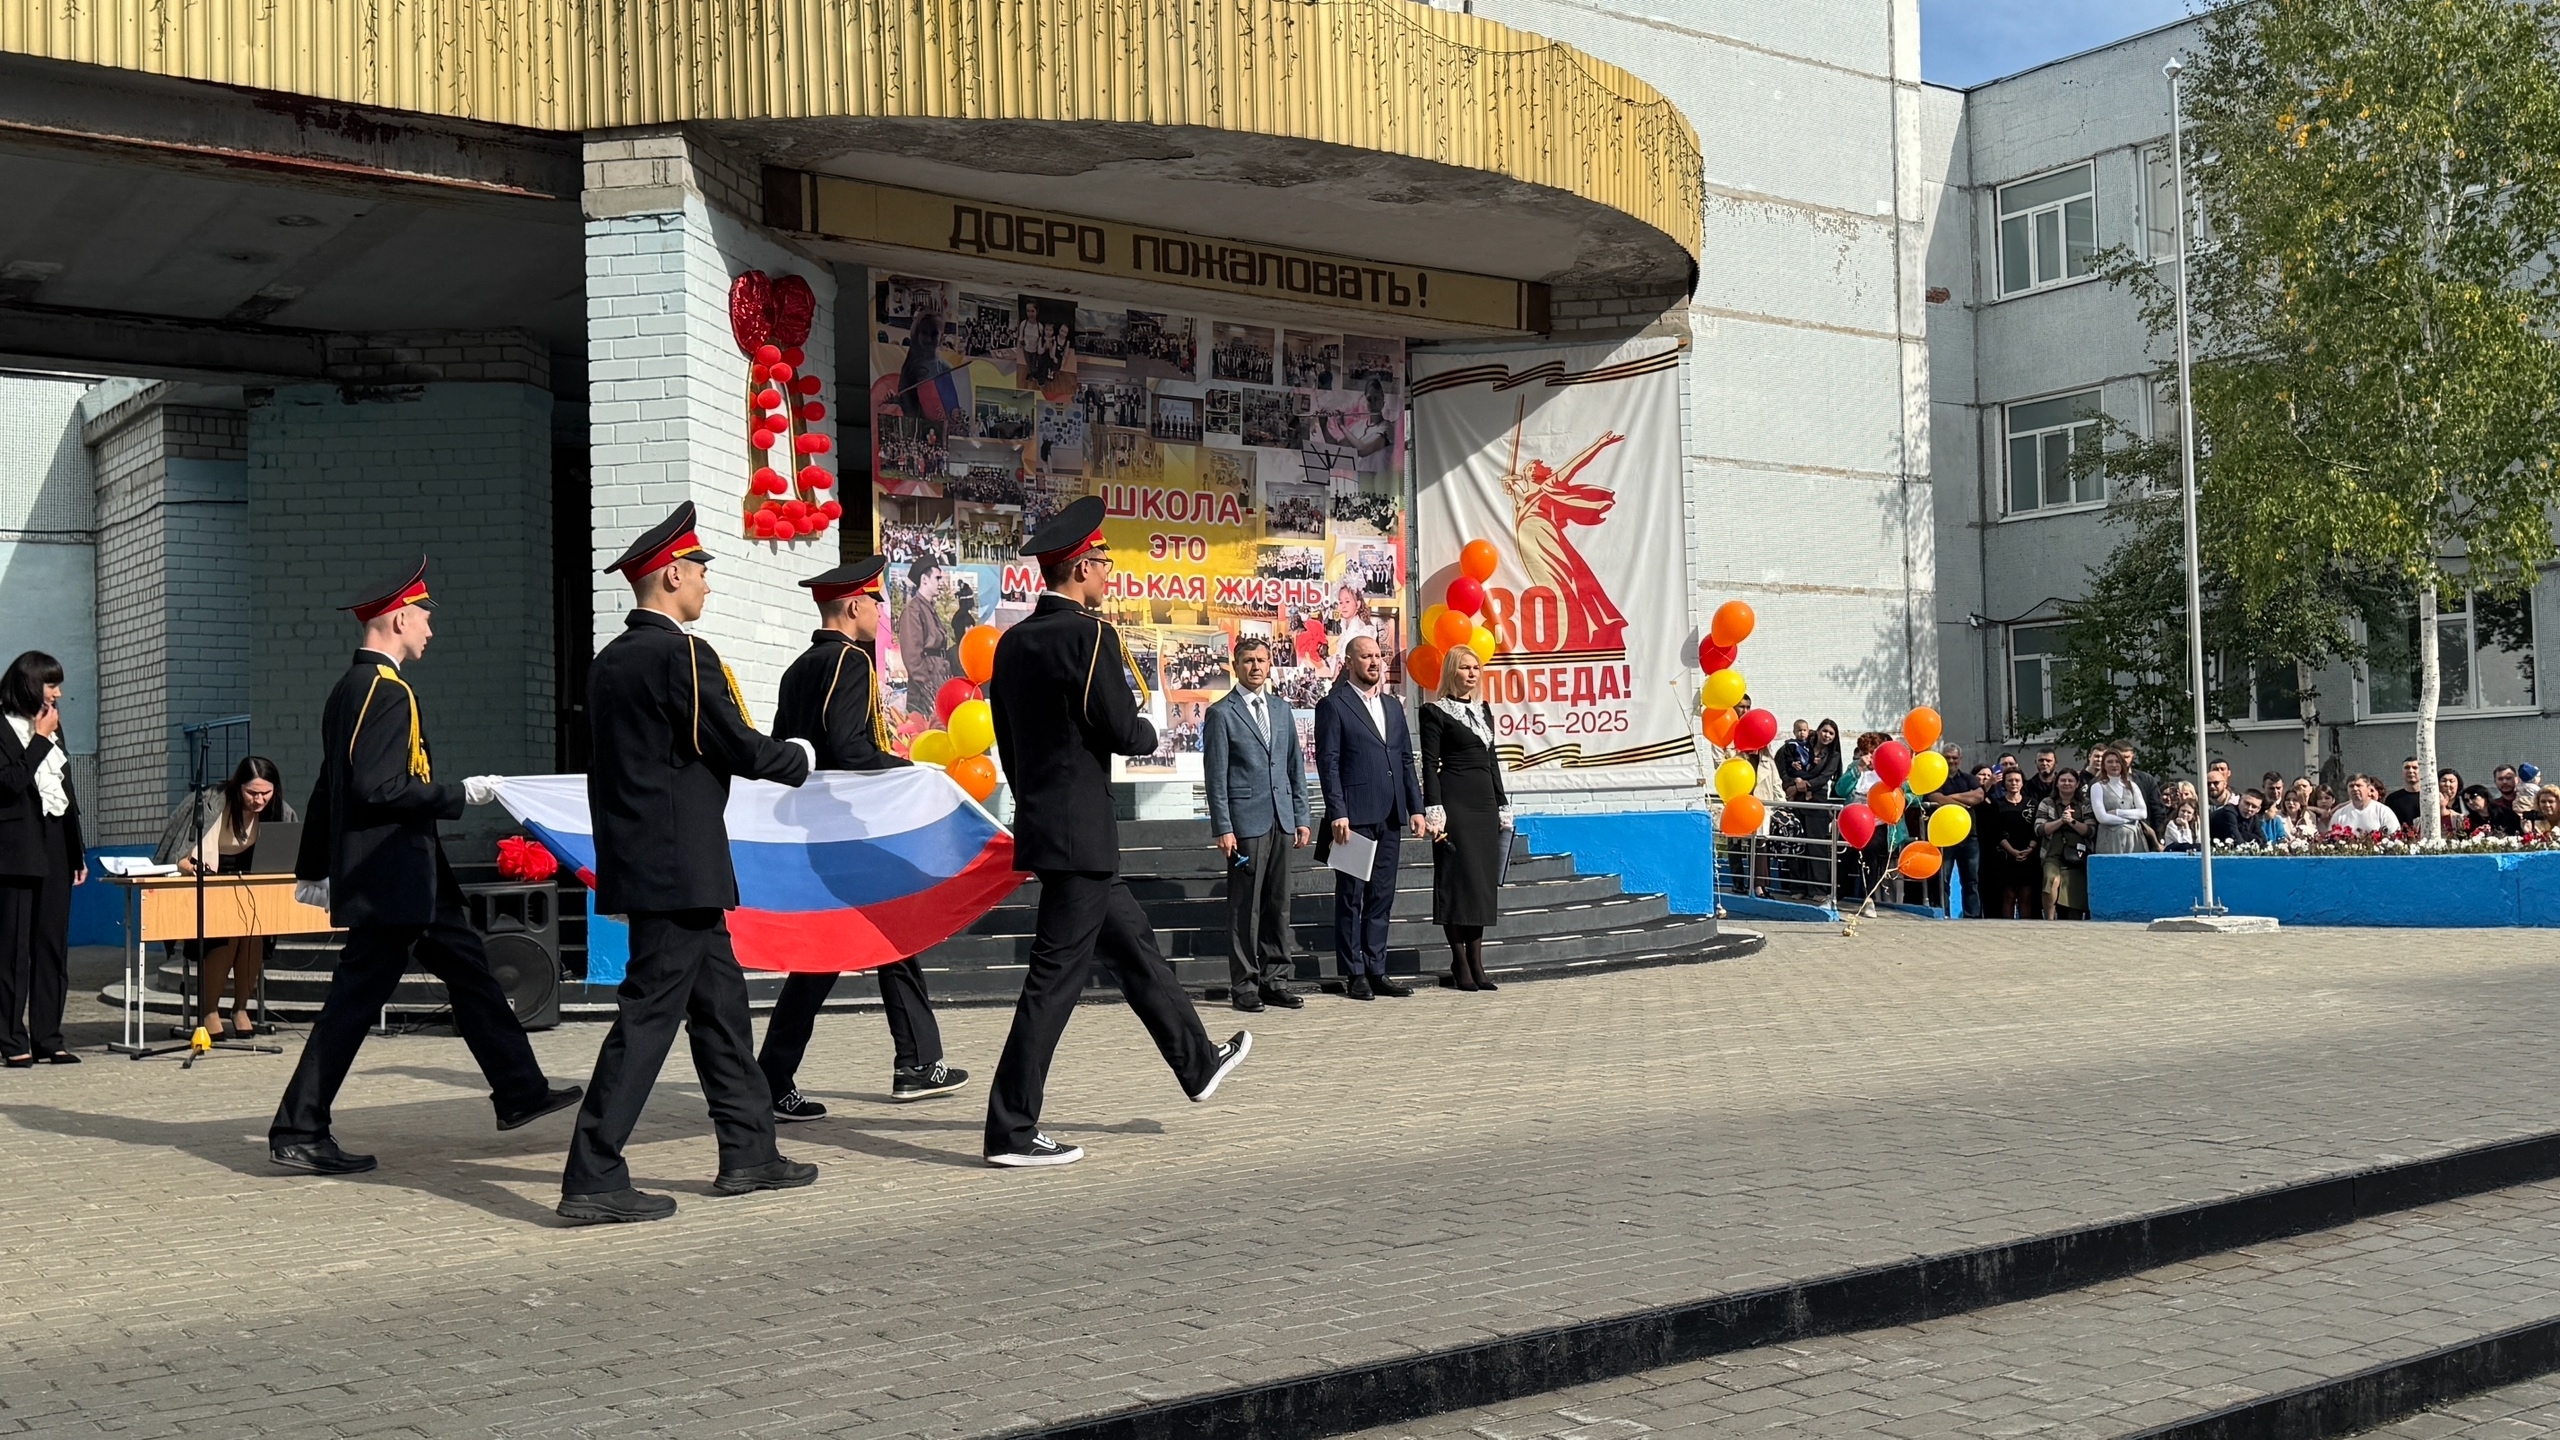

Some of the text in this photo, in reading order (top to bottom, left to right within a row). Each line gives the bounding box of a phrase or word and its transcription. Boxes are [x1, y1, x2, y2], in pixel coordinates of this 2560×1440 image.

[950, 204, 1105, 264] ДОБРО
[1149, 534, 1207, 562] ЭТО
[1003, 566, 1331, 606] МНЬКАЯ ЖИЗНЬ!
[1481, 586, 1558, 653] 80
[1483, 664, 1631, 707] ПОБЕДА!
